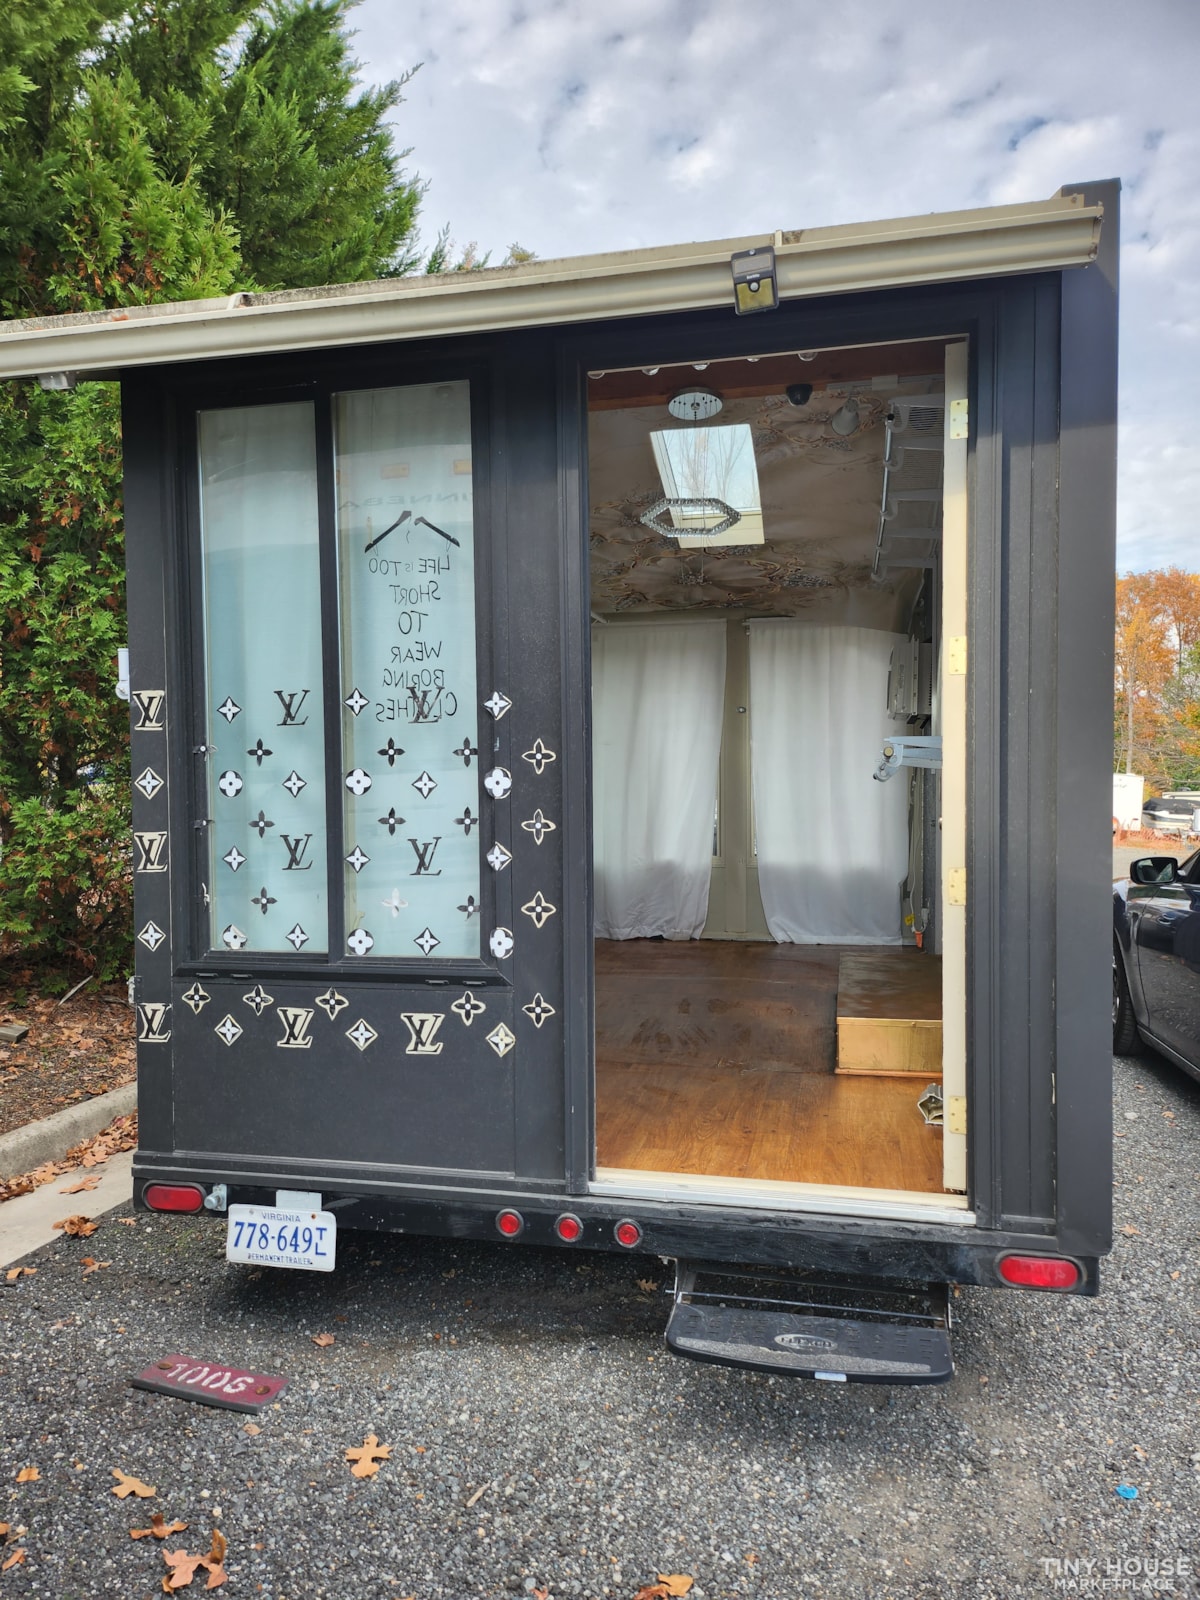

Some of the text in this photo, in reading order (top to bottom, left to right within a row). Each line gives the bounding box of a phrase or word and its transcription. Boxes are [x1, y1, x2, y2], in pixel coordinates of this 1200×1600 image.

[261, 1211, 301, 1223] VIRGINIA
[247, 1253, 312, 1265] PERMANENT TRAILER
